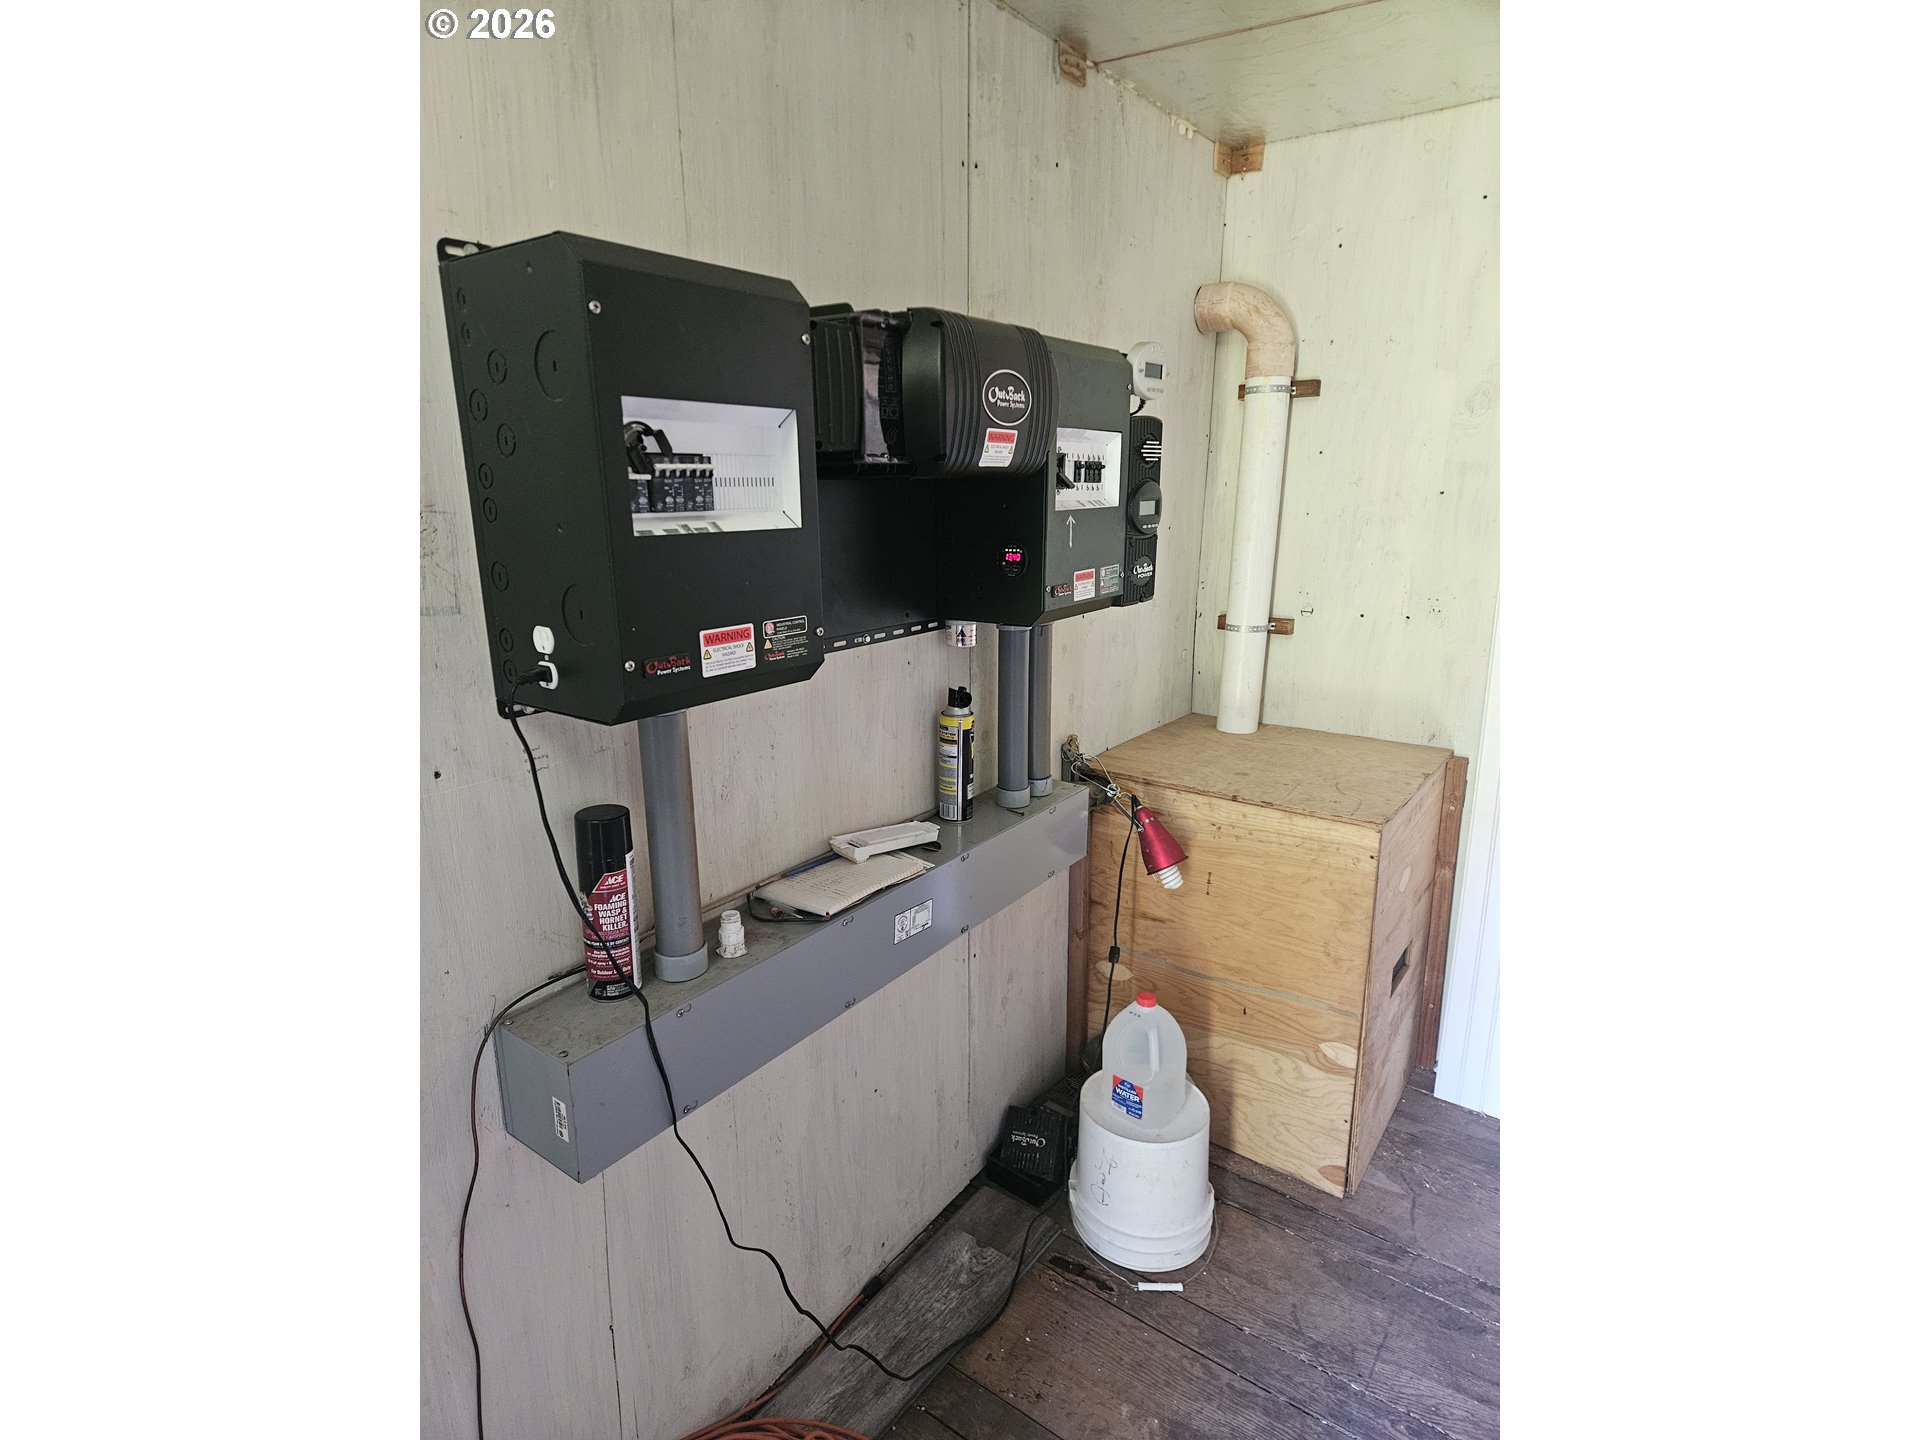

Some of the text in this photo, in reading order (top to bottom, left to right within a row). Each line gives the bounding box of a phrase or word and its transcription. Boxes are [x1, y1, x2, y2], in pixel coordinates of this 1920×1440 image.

[988, 386, 1026, 402] OutBack
[997, 400, 1010, 408] Power
[987, 432, 1015, 443] WARNING
[1133, 562, 1153, 575] OutBack
[704, 629, 750, 645] WARNING
[645, 656, 691, 674] OutBack
[604, 874, 624, 886] ACE
[609, 892, 627, 903] ACE
[593, 900, 627, 911] FOAMING
[598, 906, 628, 918] WASP &
[599, 913, 628, 925] HORNET
[1115, 1086, 1140, 1103] WATER
[1011, 1134, 1046, 1148] OutBack
